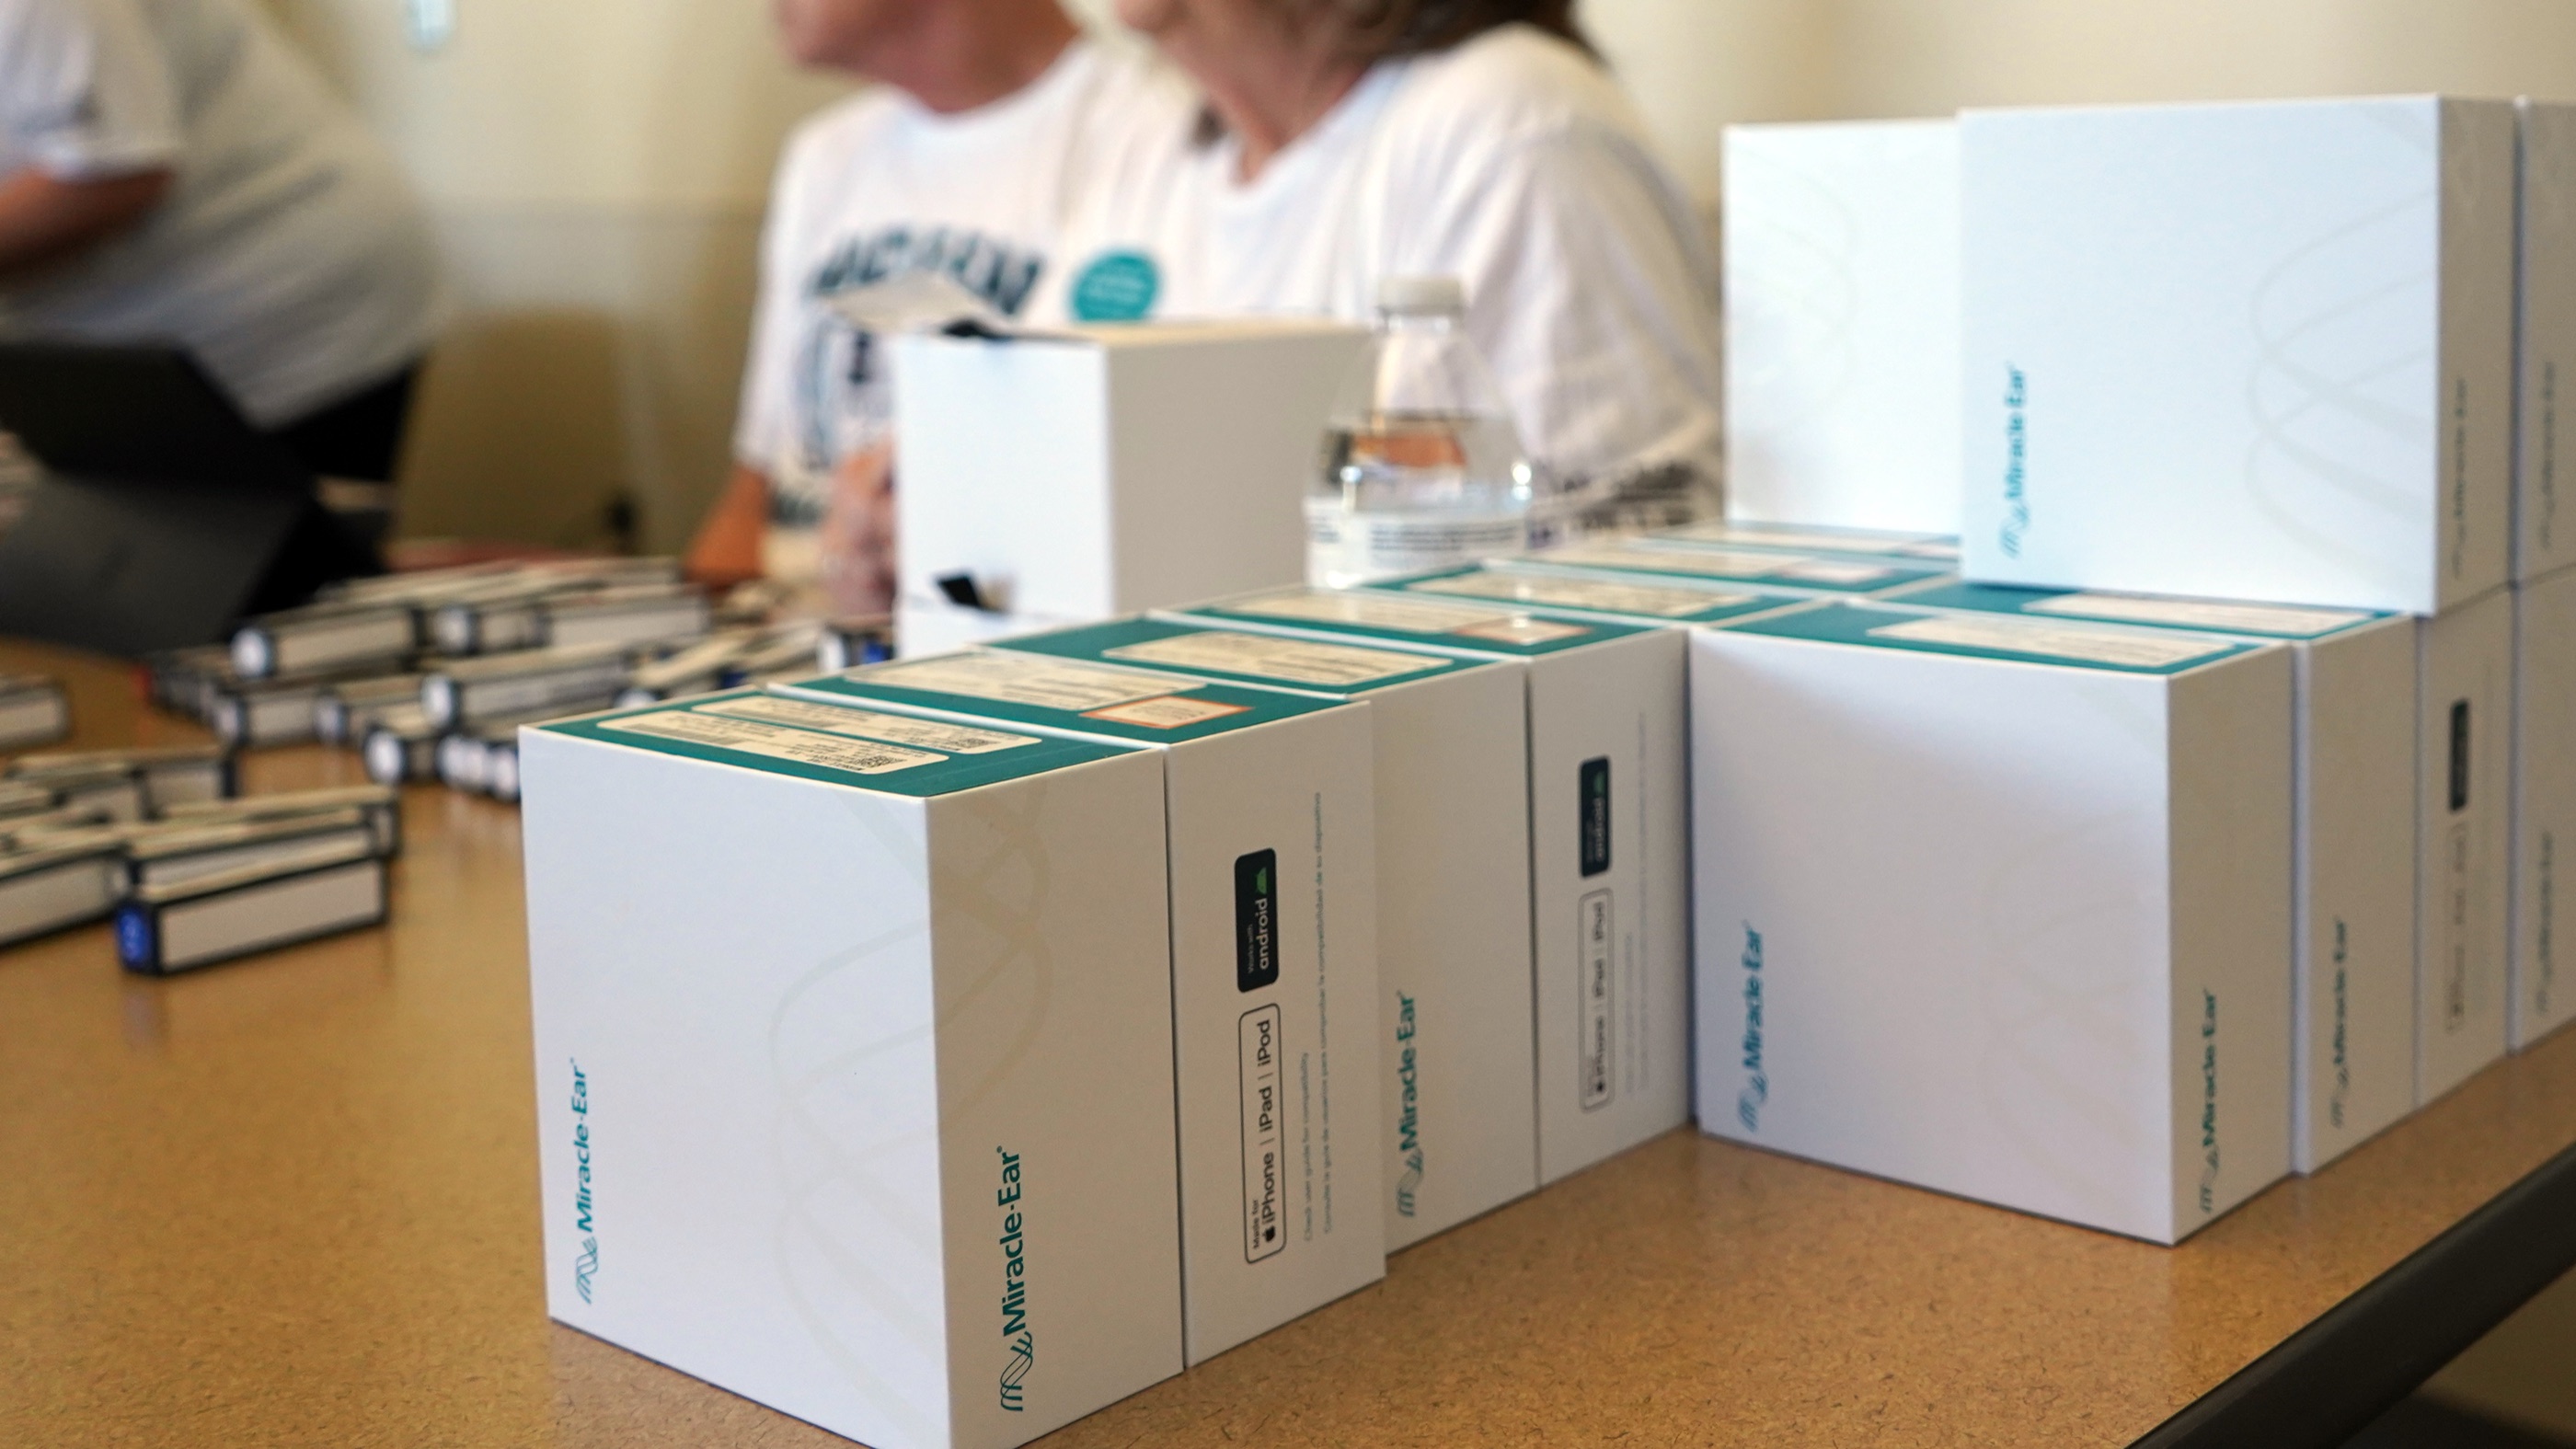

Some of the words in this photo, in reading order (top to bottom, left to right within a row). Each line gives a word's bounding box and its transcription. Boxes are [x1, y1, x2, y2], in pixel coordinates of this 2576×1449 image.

[1255, 898, 1270, 970] android
[1256, 1019, 1271, 1066] iPod
[1259, 1086, 1273, 1132] iPad
[1261, 1152, 1275, 1225] iPhone
[996, 1150, 1027, 1337] Miracle-Ear
